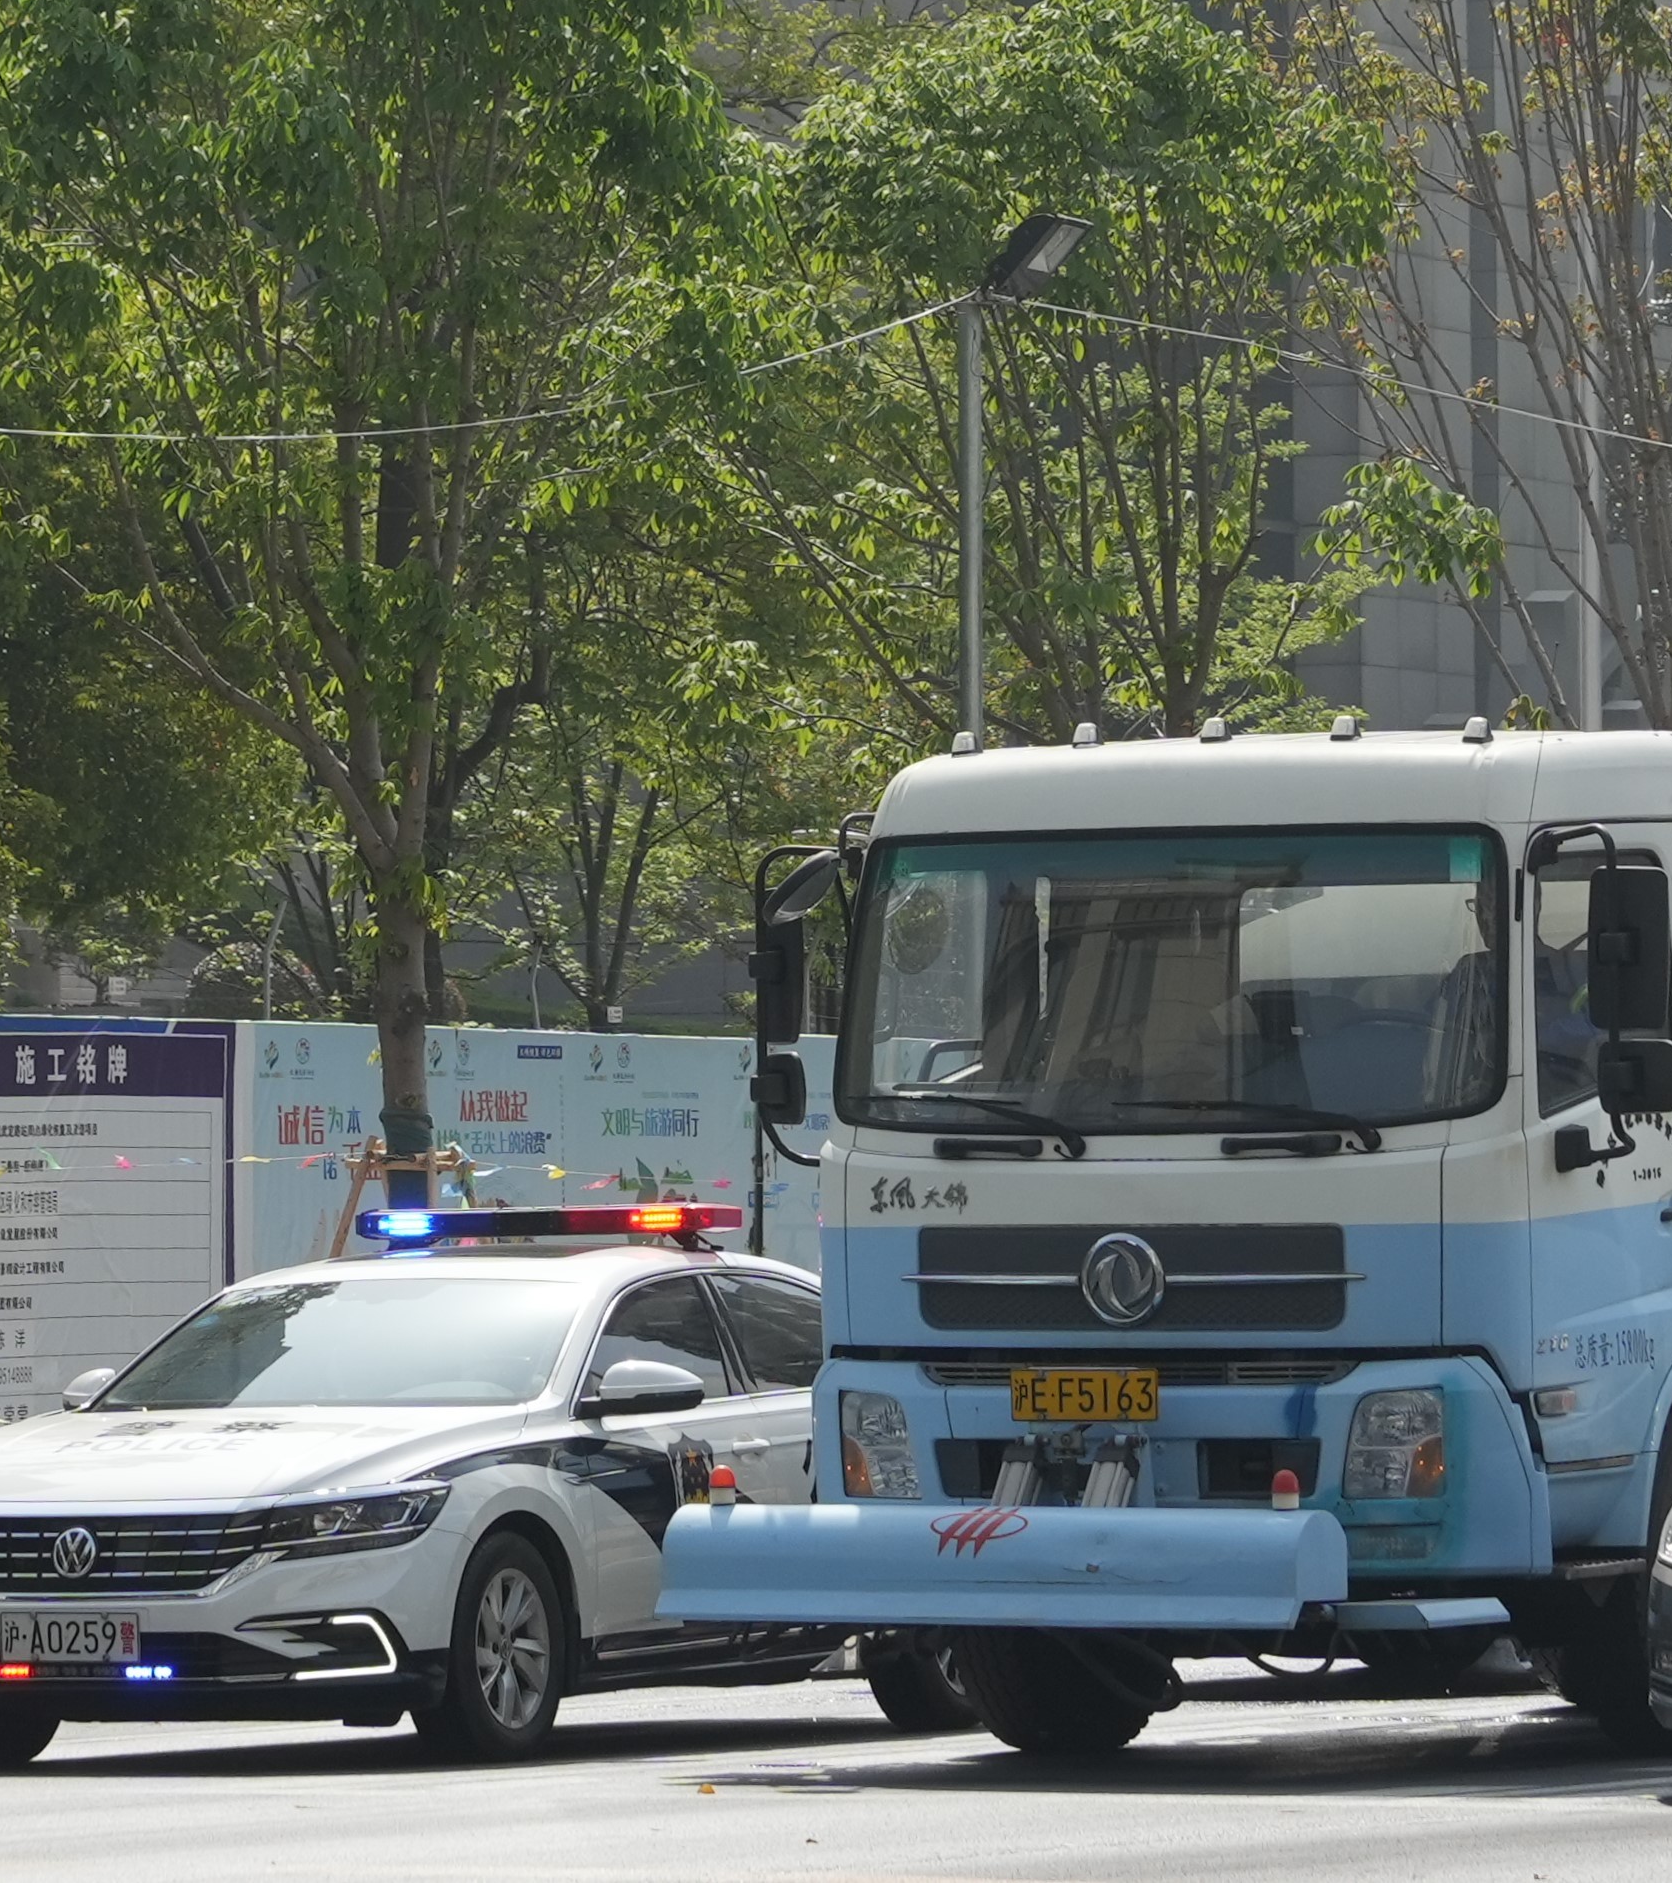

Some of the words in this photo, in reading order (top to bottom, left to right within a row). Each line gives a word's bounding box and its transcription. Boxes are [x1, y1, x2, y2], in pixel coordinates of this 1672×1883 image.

[15, 1044, 128, 1085] 施工铭牌
[460, 1090, 529, 1122] 从我做起
[277, 1105, 362, 1145] 诚信为本
[601, 1108, 700, 1137] 文明与旅游同行
[55, 1437, 254, 1454] POLICE
